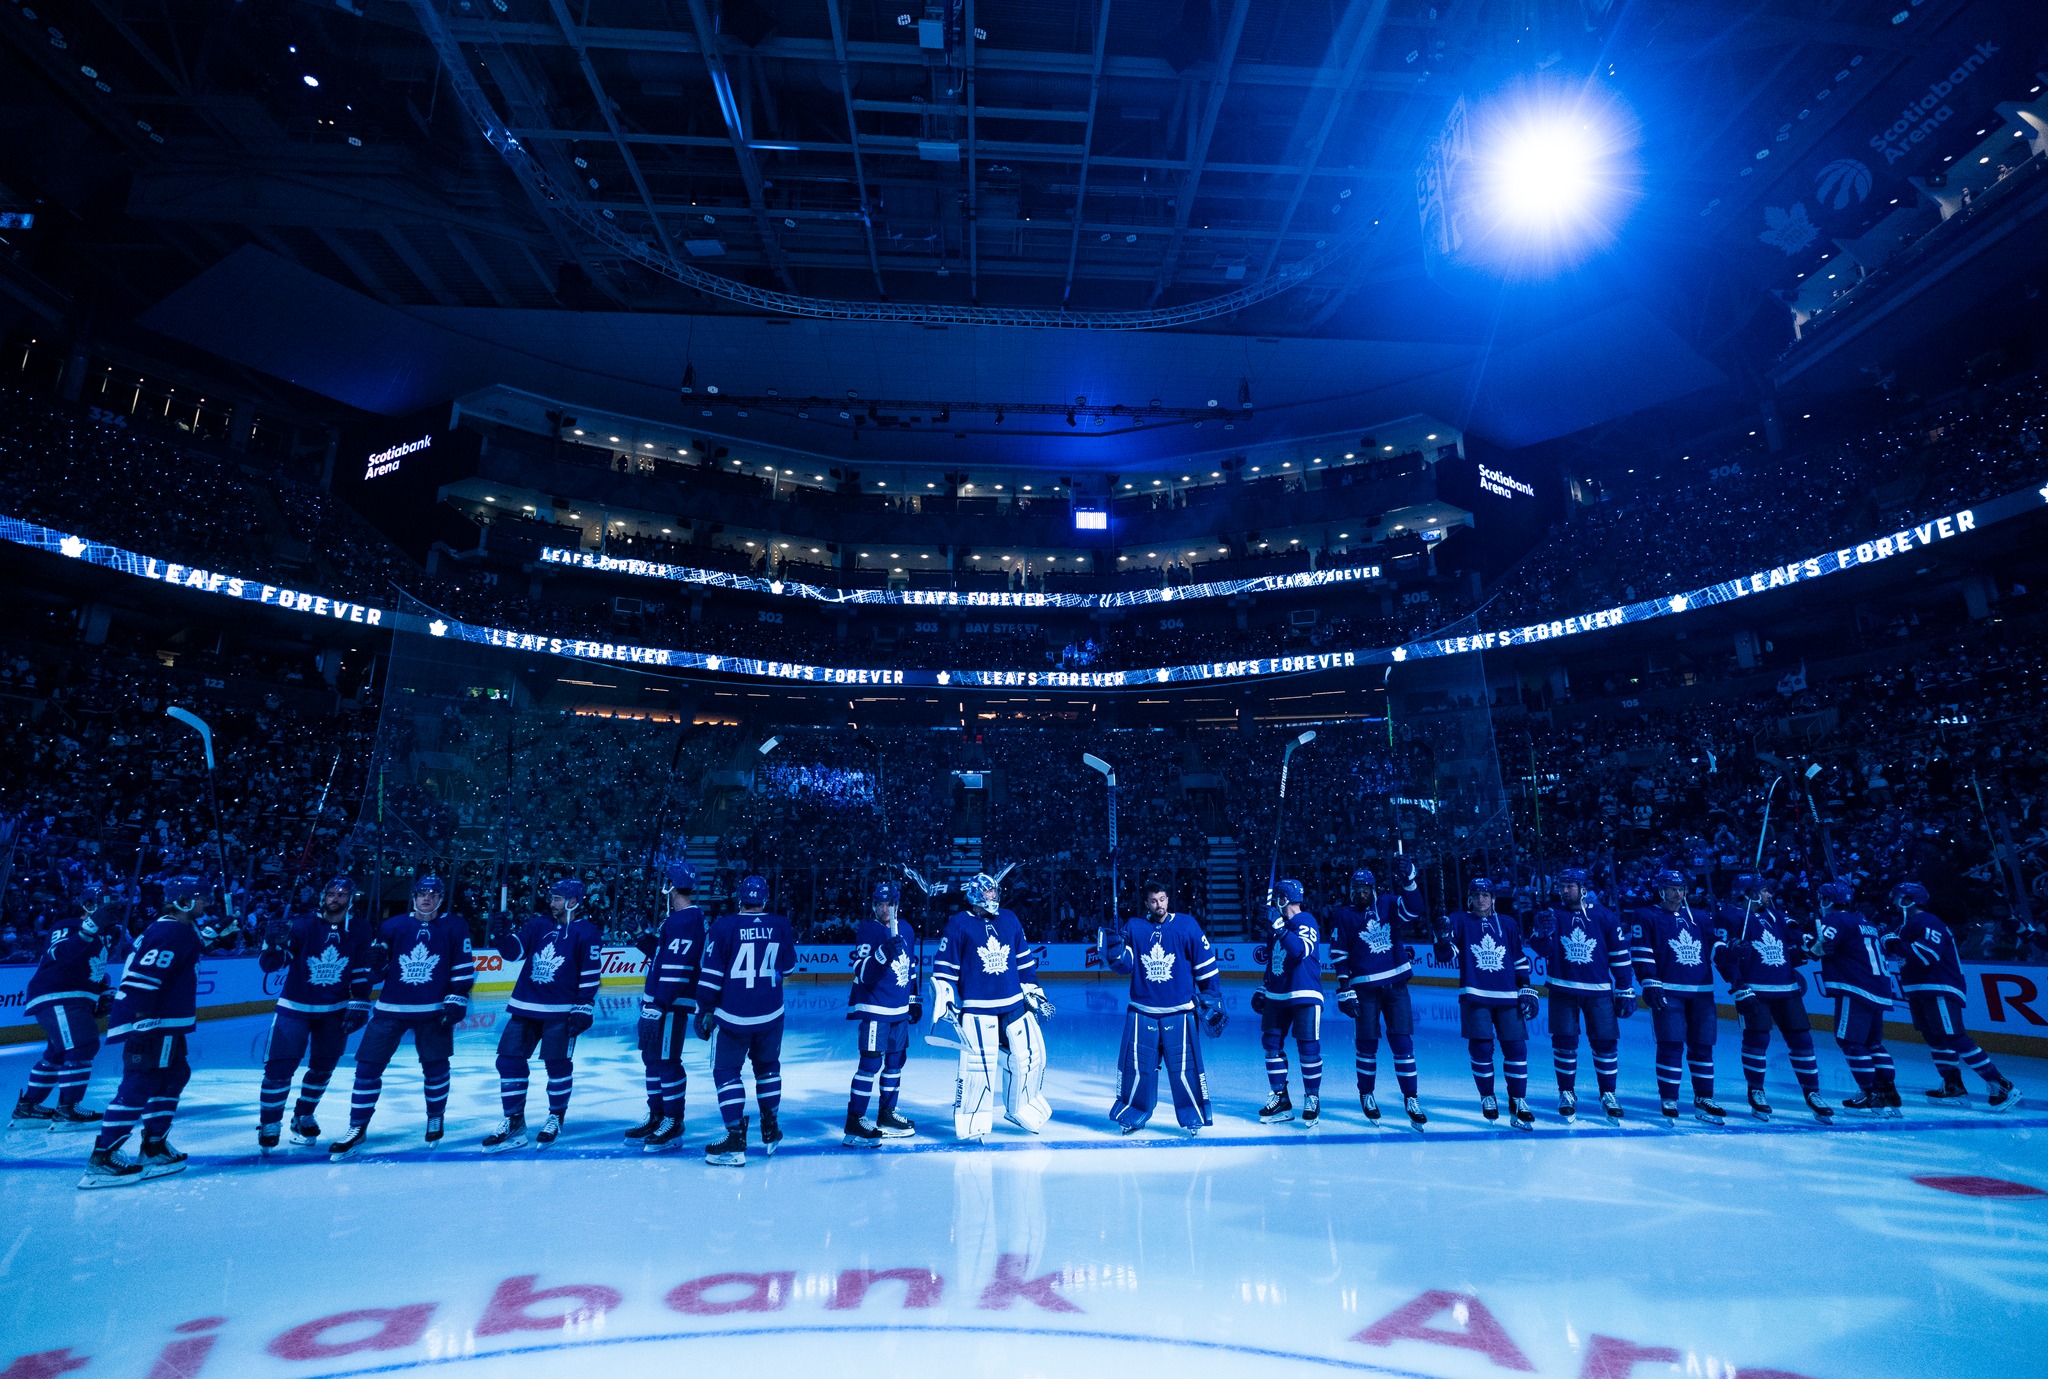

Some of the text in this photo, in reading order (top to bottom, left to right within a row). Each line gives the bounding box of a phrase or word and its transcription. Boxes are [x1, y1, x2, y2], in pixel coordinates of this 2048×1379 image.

[1870, 40, 2000, 152] Scotiabank
[1885, 105, 1953, 165] Arena
[367, 434, 432, 467] Scotiabank
[364, 459, 400, 480] Arena
[1709, 462, 1741, 480] 306
[1478, 463, 1535, 497] Scotiabank
[1480, 476, 1512, 499] Arena
[1735, 509, 1976, 597] LEAFS FOREVER
[542, 549, 667, 577] LEAFS FOREVER
[1317, 566, 1380, 585] FOREVER
[147, 558, 382, 626] LEAFS FOREVER
[904, 590, 1045, 607] LEAFS FOREVER
[1402, 591, 1430, 605] 305
[758, 611, 783, 624] 302
[1159, 618, 1184, 631] 304
[914, 622, 939, 633] 303
[965, 622, 990, 633] BAY
[1445, 608, 1624, 654] LEAFS FOREVER
[492, 629, 669, 665] LEAFS FOREVER
[757, 661, 903, 684] LEAFS FOREVER
[1203, 651, 1355, 679] LEAFS FOREVER
[204, 678, 225, 689] 122
[983, 671, 1124, 687] LEAFS FOREVER
[1621, 698, 1640, 708] 105
[739, 927, 774, 941] RIELLY
[1299, 925, 1318, 942] 25
[1630, 924, 1642, 939] 9
[1925, 927, 1943, 944] 15
[463, 938, 472, 953] 8
[668, 938, 693, 955] 47
[1215, 948, 1235, 961] LG
[1761, 945, 1782, 953] TORONTO
[139, 949, 175, 968] 88
[472, 955, 502, 971] za
[600, 951, 634, 974] Tim
[729, 942, 780, 989] 44
[1199, 1072, 1209, 1100] VAUGHN
